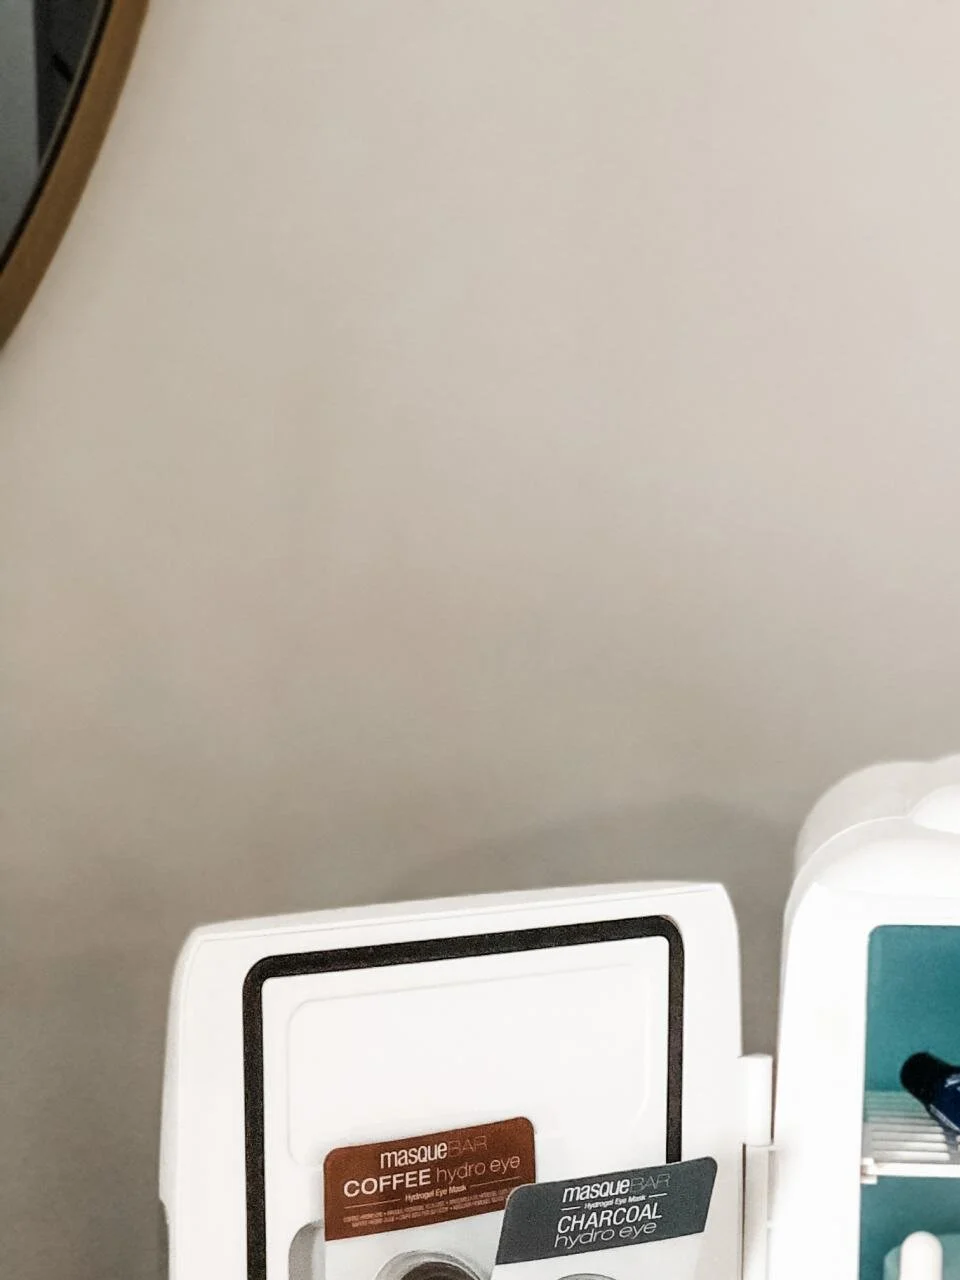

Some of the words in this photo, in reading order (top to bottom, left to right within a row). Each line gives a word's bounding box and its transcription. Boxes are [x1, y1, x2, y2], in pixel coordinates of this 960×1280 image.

[344, 1168, 431, 1198] COFFEE
[437, 1162, 485, 1184] hydro
[490, 1155, 520, 1174] eye
[405, 1189, 434, 1202] Hydrogel
[435, 1188, 447, 1197] Eye
[449, 1184, 467, 1194] Mask
[583, 1200, 614, 1210] Hydrogel
[614, 1197, 627, 1205] Eye
[628, 1195, 646, 1203] Mask
[557, 1202, 663, 1233] CHARCOAL
[554, 1228, 614, 1250] hydro
[619, 1222, 657, 1240] eye
